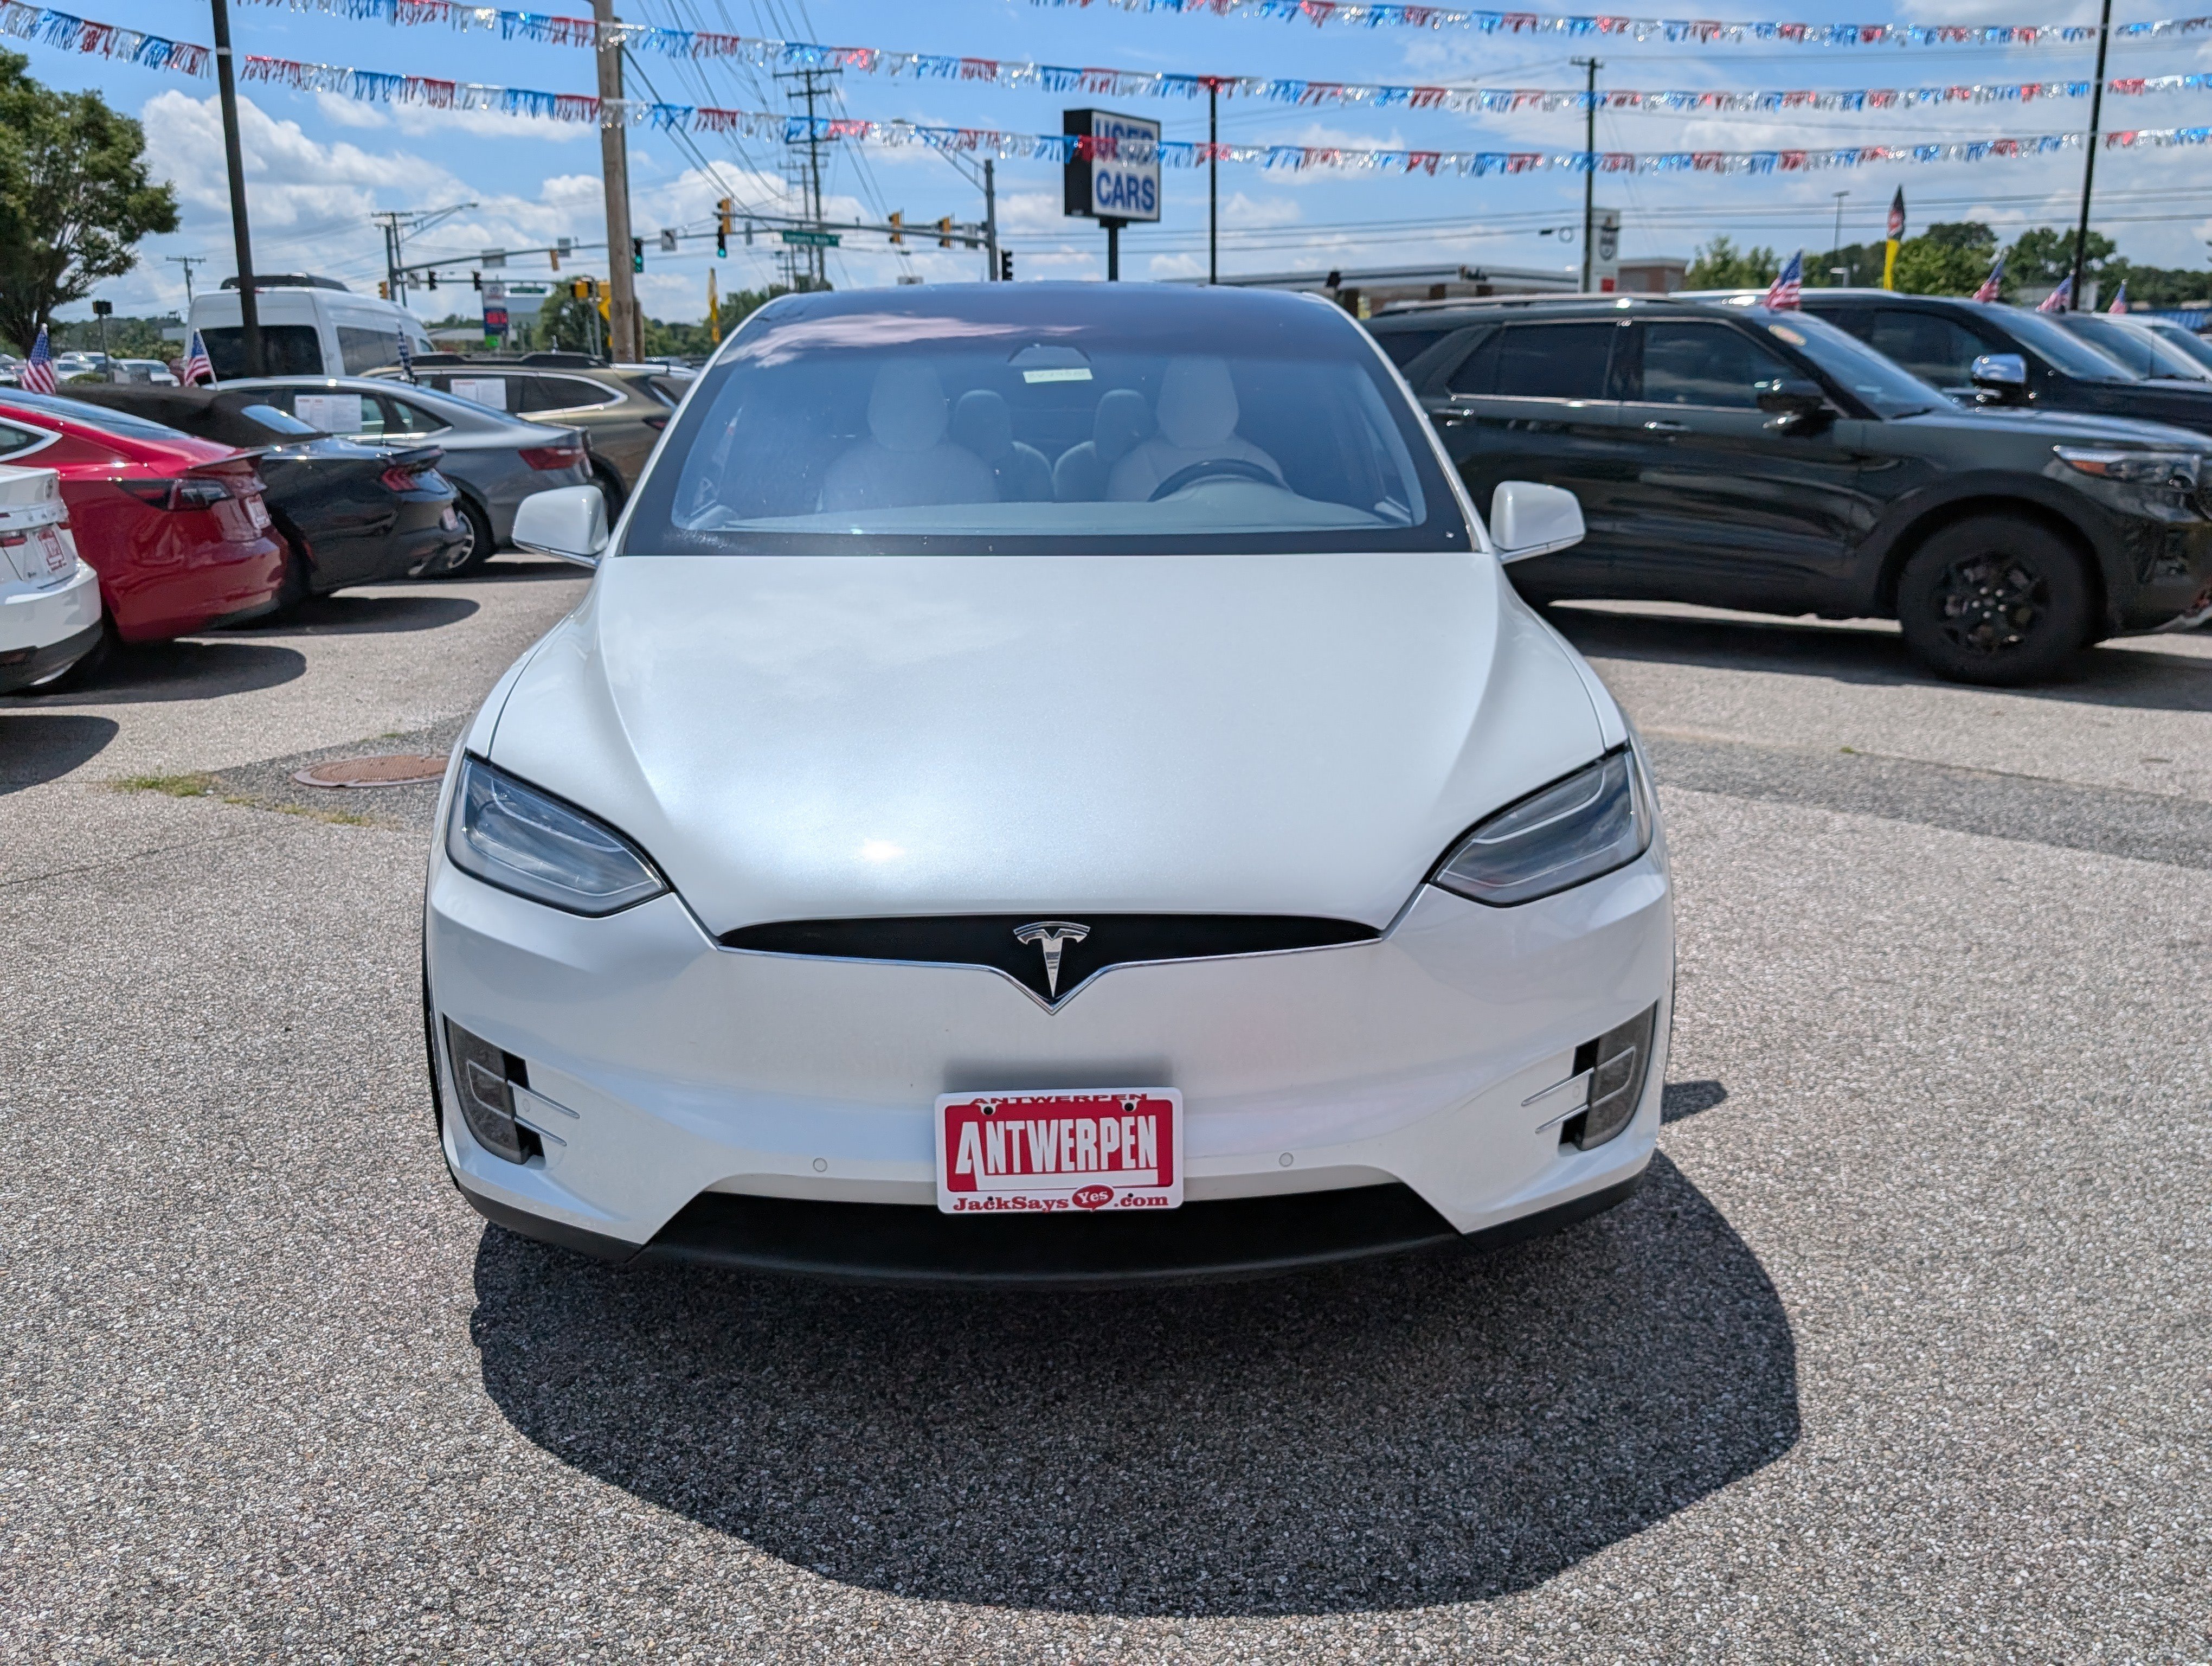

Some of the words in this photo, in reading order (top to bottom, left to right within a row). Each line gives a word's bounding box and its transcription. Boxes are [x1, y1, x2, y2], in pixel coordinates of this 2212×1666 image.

[1096, 169, 1155, 212] CARS
[955, 1115, 1158, 1175] ANTWERPEN
[953, 1196, 1069, 1213] JackSays
[1077, 1190, 1108, 1203] Yes
